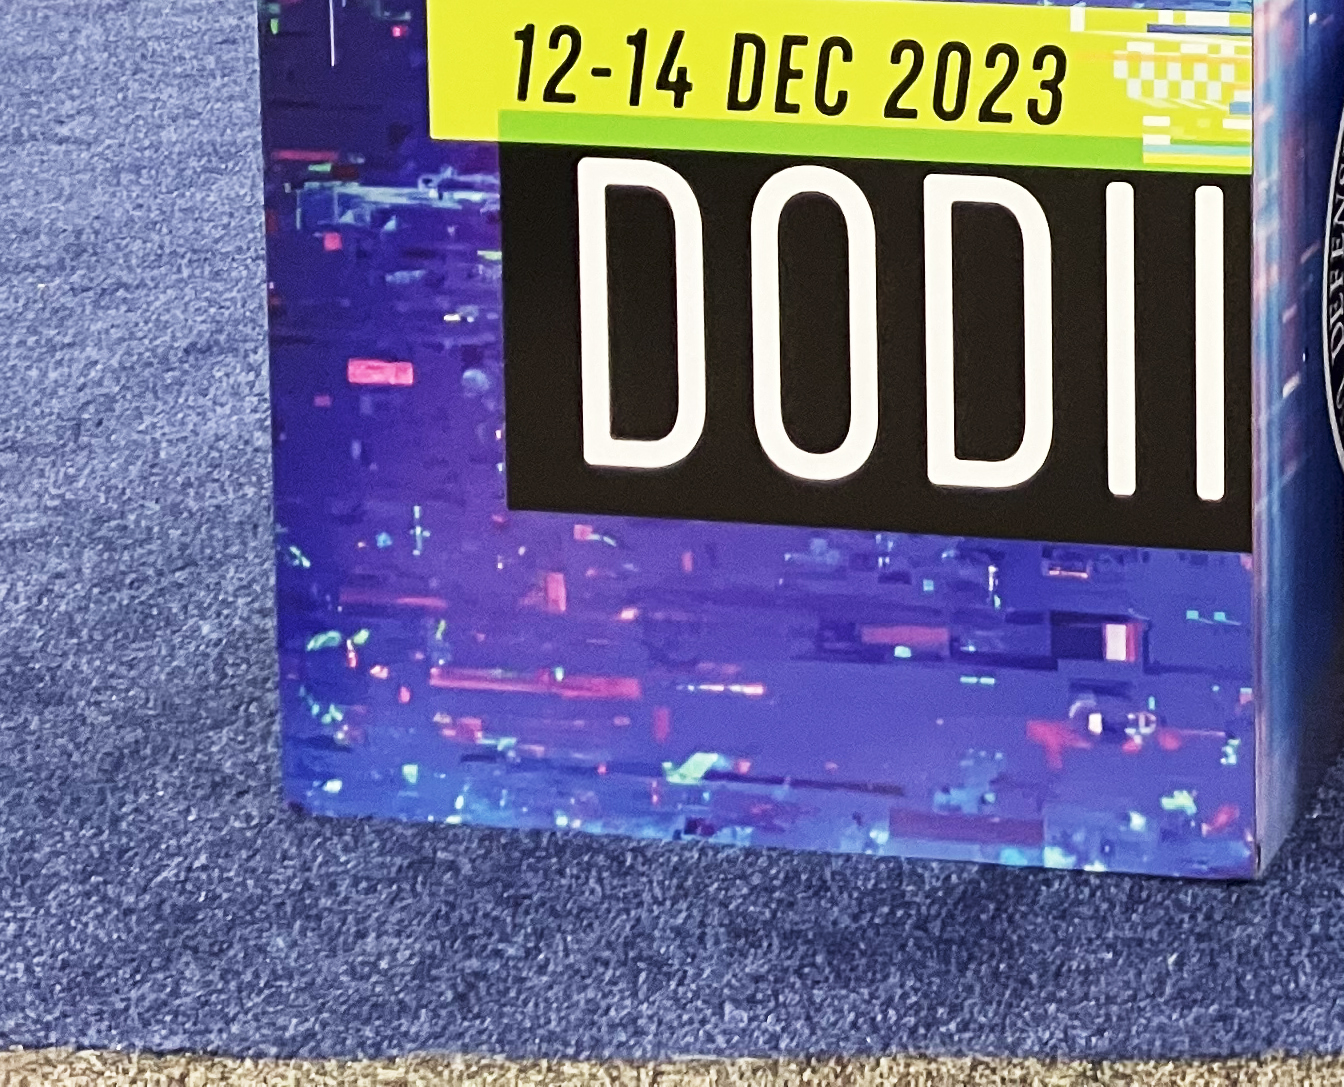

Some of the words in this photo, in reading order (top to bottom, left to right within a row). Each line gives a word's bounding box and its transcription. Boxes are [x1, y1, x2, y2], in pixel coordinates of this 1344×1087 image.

[512, 23, 694, 109] 12-14
[727, 31, 853, 116] DEC
[883, 39, 1068, 126] 2023
[576, 156, 1226, 502] DODII
